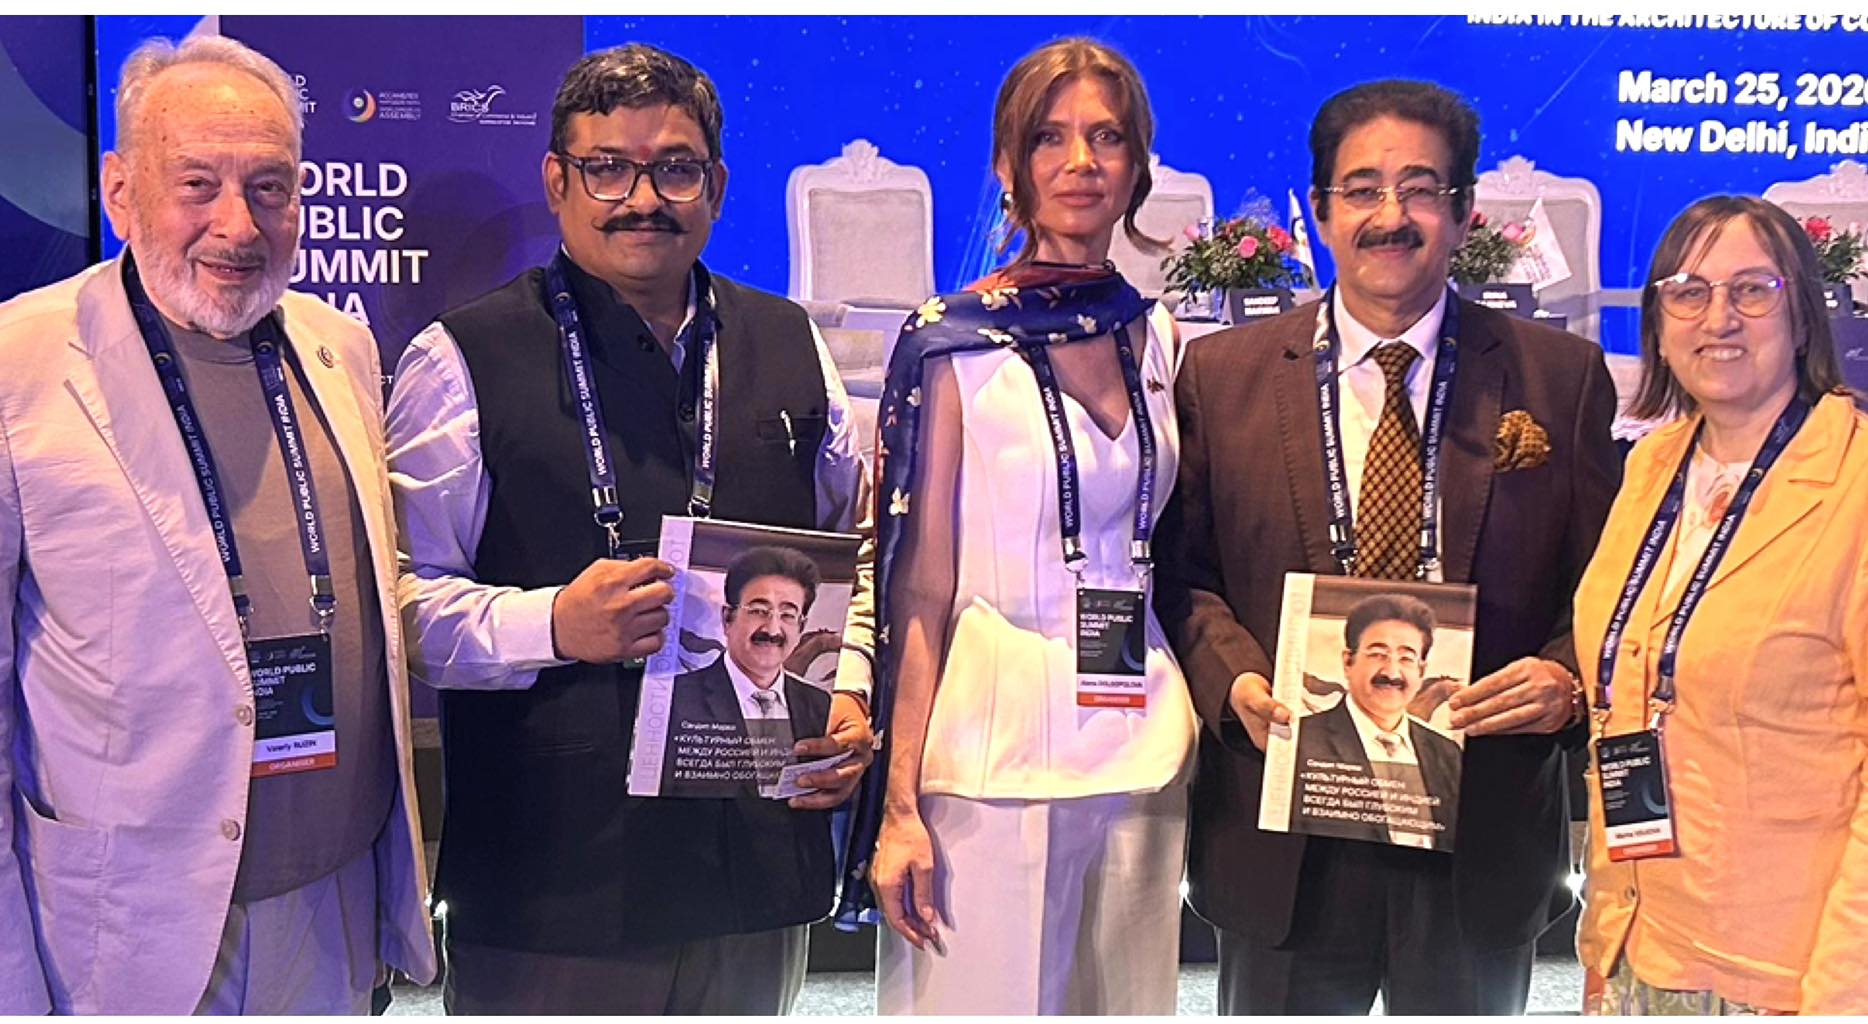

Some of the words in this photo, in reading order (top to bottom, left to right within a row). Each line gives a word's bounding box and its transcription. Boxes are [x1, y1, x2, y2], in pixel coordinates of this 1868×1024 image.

[1570, 15, 1615, 27] THE
[1617, 15, 1802, 30] ARCHITECTURE
[1617, 71, 1727, 104] March
[1734, 73, 1788, 111] 25,
[1616, 120, 1693, 152] New
[1700, 121, 1797, 159] Delhi,
[300, 161, 408, 197] ORLD
[289, 249, 429, 285] UMMIT
[567, 331, 581, 358] INDIA
[573, 360, 590, 399] SUMMIT
[1321, 383, 1330, 408] INDIA
[274, 394, 290, 423] INDIA
[582, 401, 599, 436] PUBLIC
[1323, 410, 1334, 446] SUMMIT
[283, 424, 302, 468] SUMMIT
[591, 437, 607, 475] WORLD
[1326, 447, 1338, 480] PUBLIC
[296, 470, 311, 510] PUBLIC
[1331, 482, 1344, 517] WORLD
[304, 511, 319, 552] WORLD
[283, 662, 316, 674] PUBLIC
[677, 746, 713, 756] МЕЖДУ
[1304, 783, 1340, 795] МЕЖДУ
